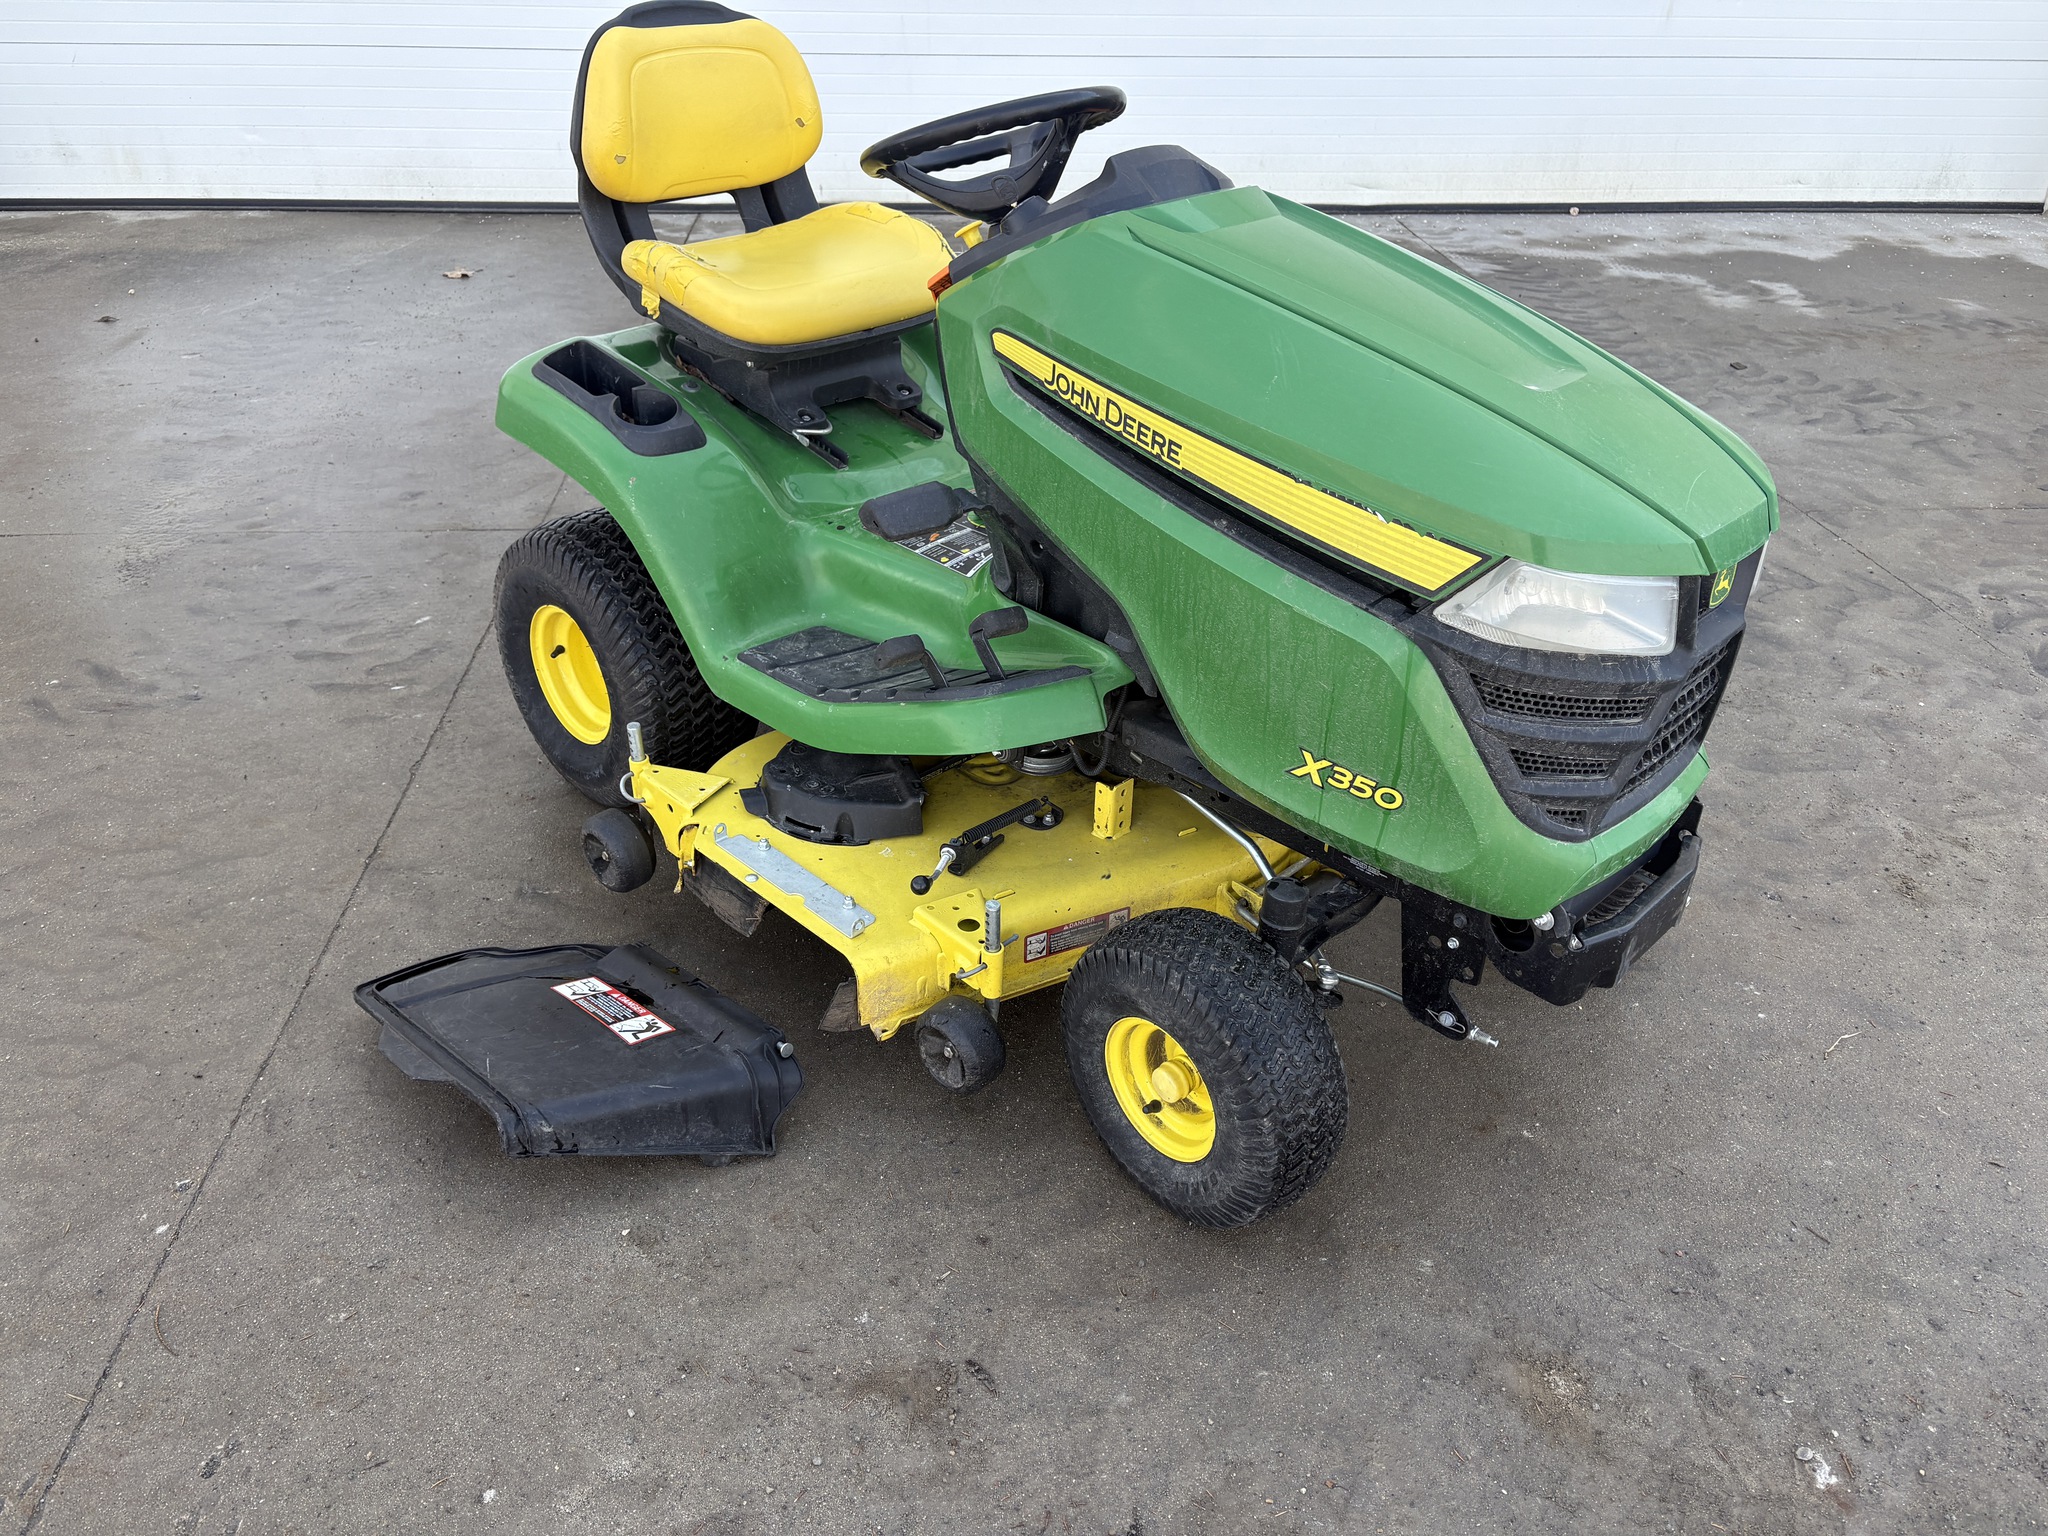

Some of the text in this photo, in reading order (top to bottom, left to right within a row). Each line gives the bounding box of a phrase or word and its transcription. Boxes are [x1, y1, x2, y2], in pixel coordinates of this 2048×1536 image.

[1044, 363, 1183, 465] JOHN DEERE
[1285, 747, 1404, 810] X350
[1069, 917, 1095, 929] DANGER
[618, 996, 647, 1014] DANGER
